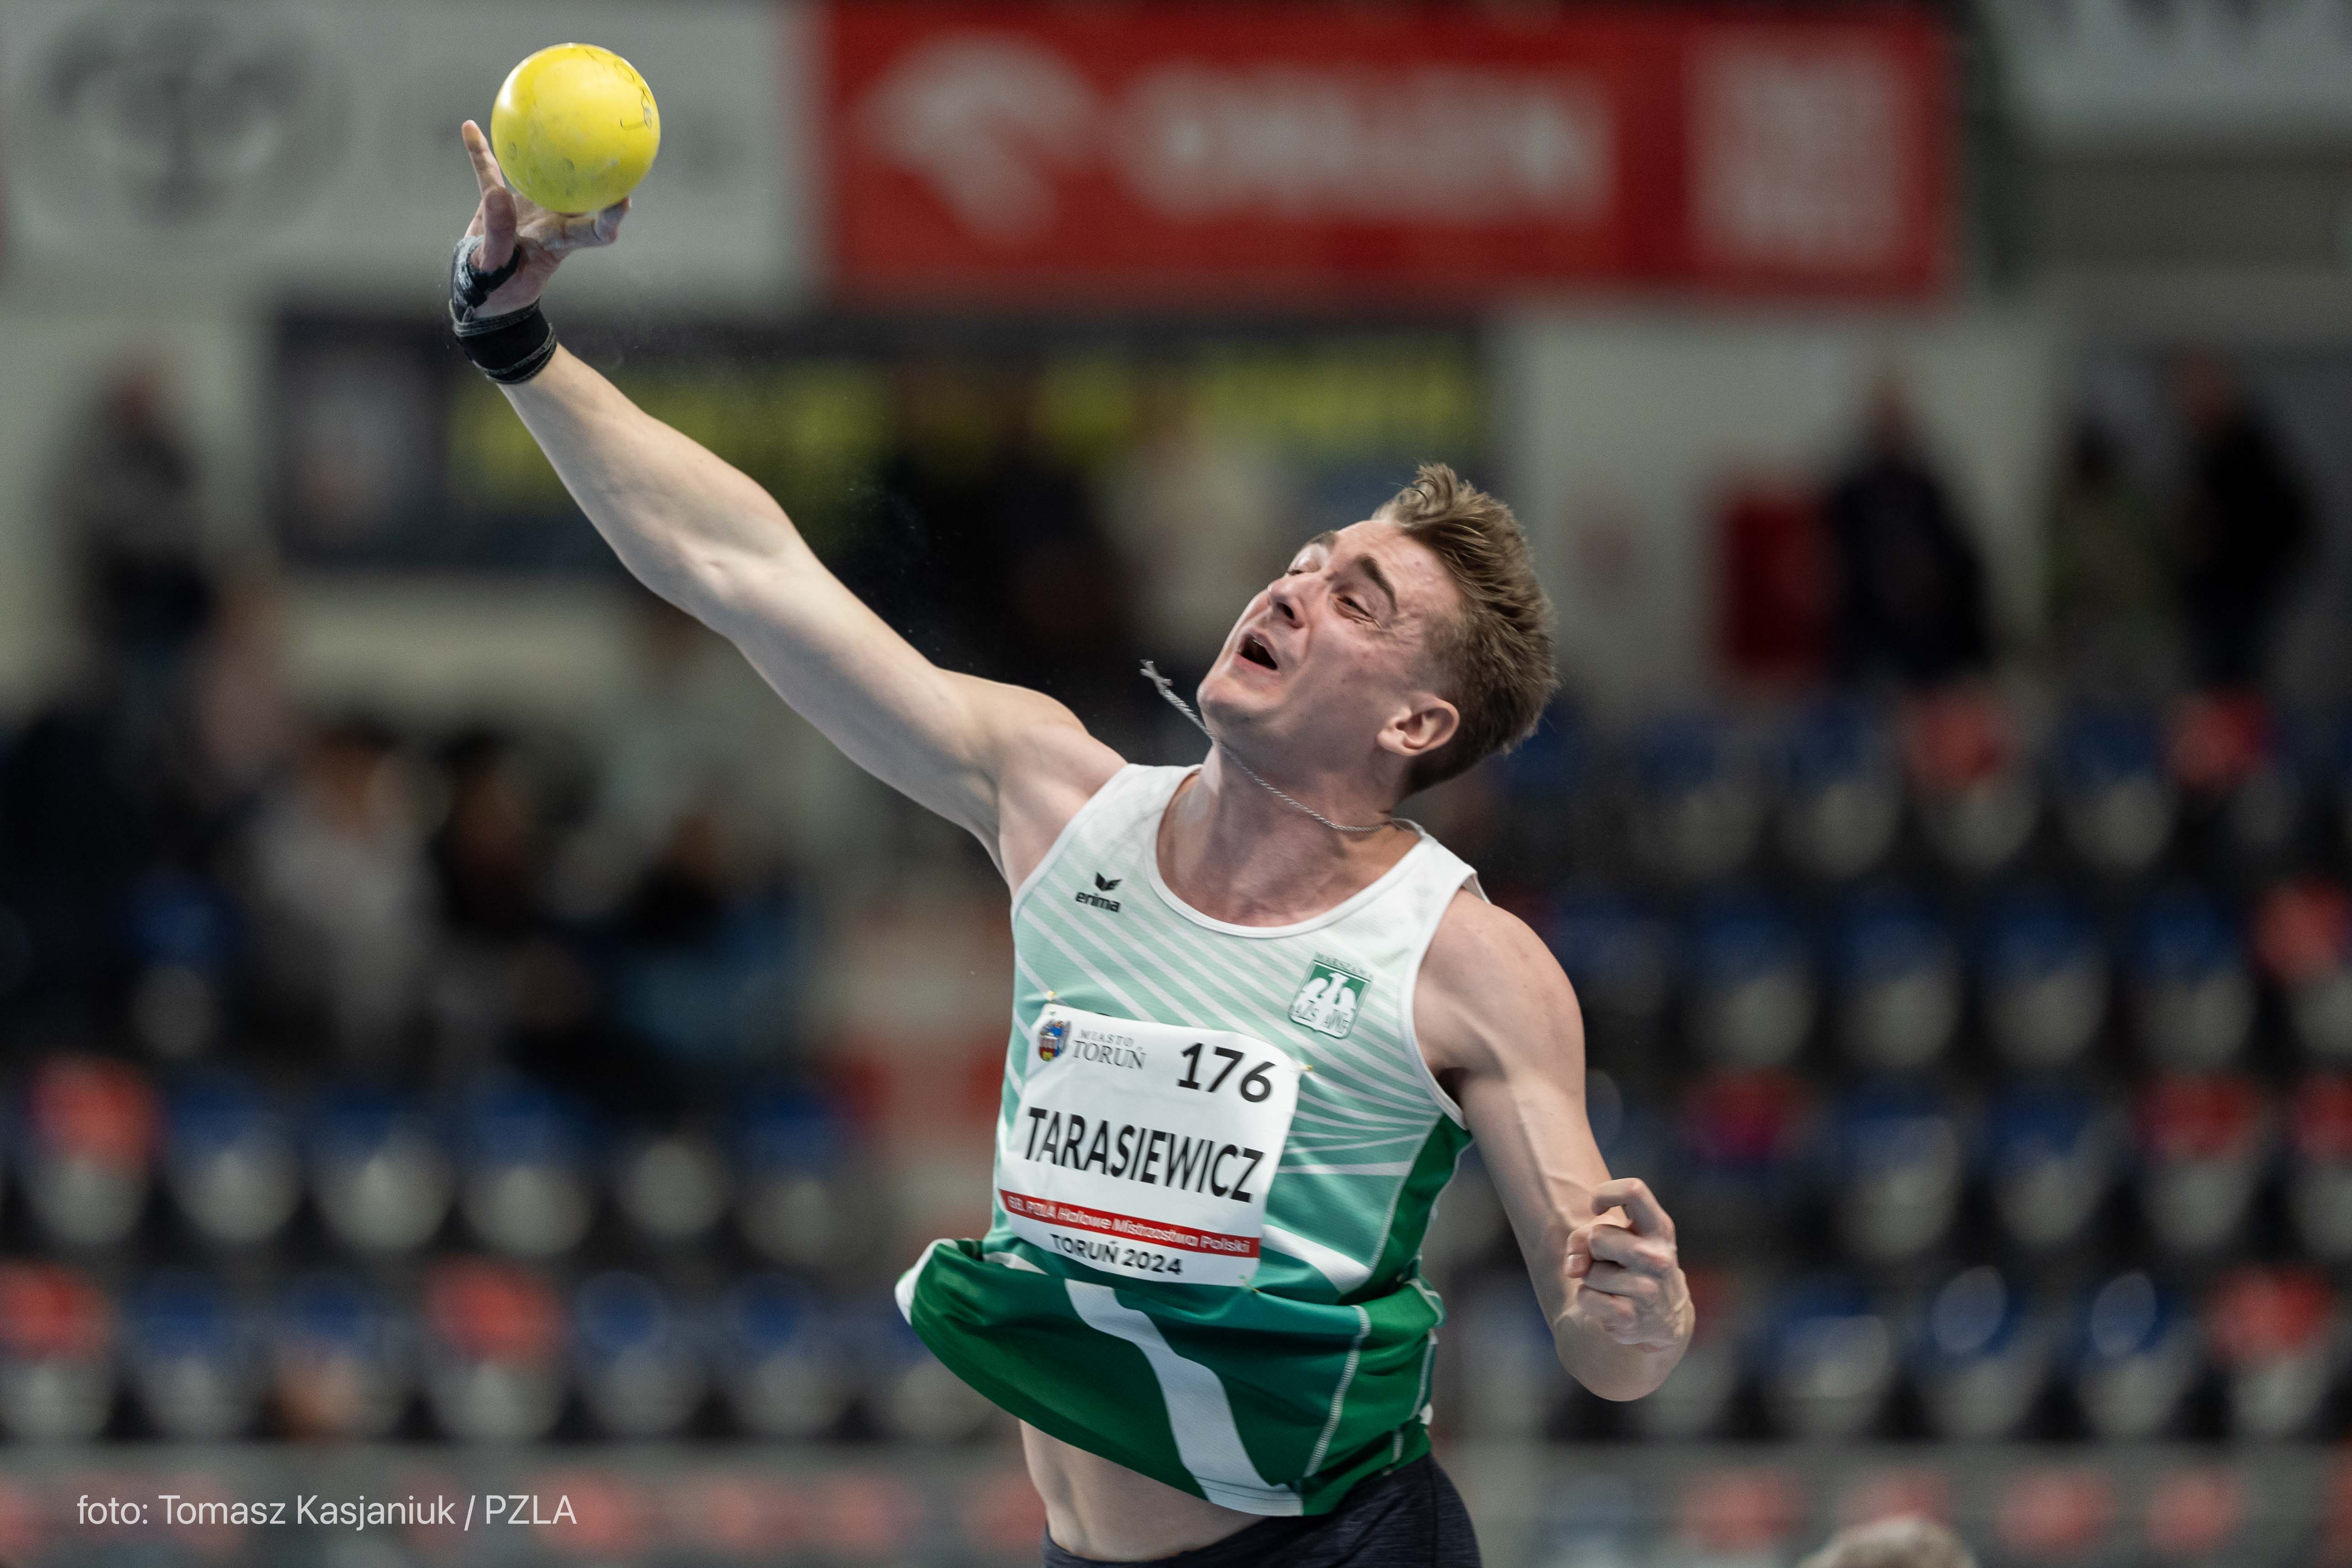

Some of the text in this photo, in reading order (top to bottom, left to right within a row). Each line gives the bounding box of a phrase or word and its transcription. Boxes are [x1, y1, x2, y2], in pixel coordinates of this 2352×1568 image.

[1075, 892, 1121, 913] erima
[1079, 1029, 1134, 1047] MIASTO
[1072, 1039, 1148, 1070] TORUŃ
[1176, 1043, 1277, 1103] 176
[1023, 1106, 1265, 1203] TARASIEWICZ
[1050, 1233, 1183, 1275] TORUŃ 2024
[1200, 1234, 1250, 1253] Polski
